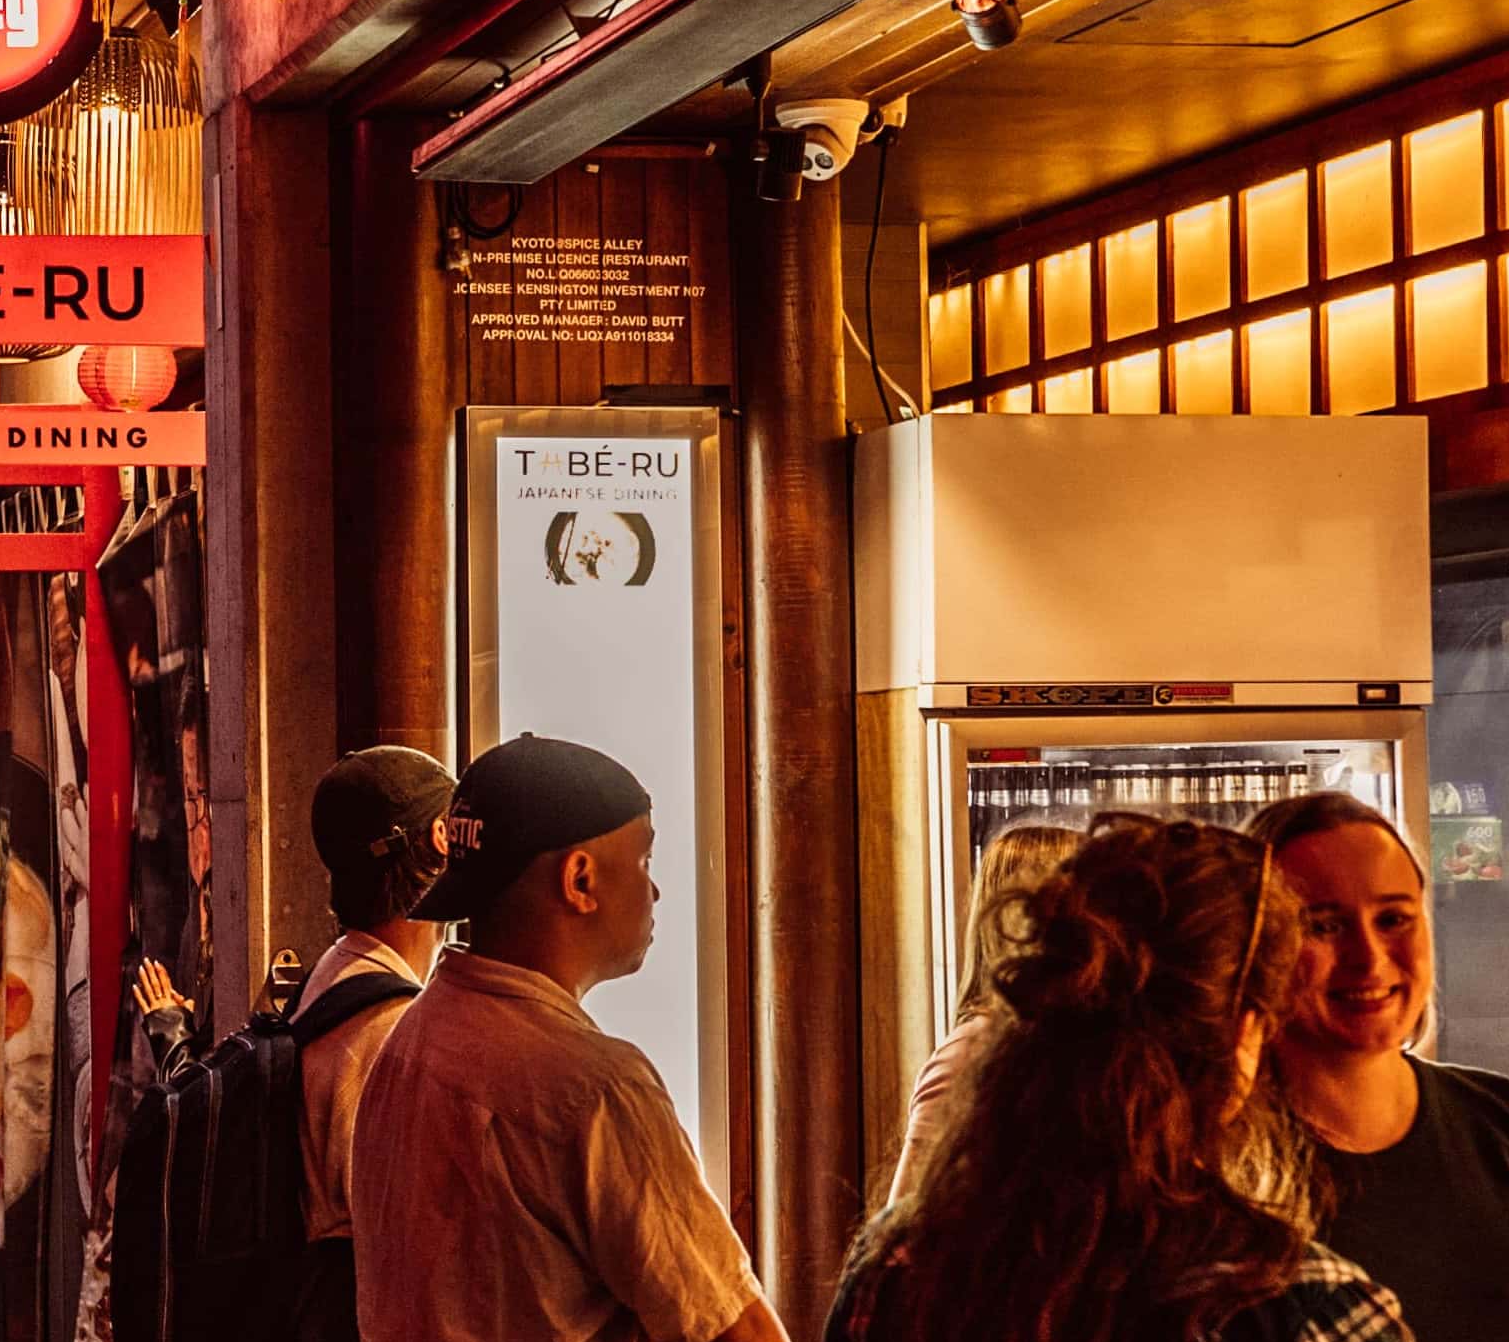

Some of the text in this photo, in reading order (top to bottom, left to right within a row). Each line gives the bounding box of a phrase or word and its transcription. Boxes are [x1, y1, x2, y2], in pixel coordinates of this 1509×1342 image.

[511, 237, 555, 249] KYOTO
[603, 238, 643, 251] ALLEY
[472, 252, 543, 264] N-PREMISE
[545, 253, 600, 265] LICENCE
[453, 282, 513, 295] ICENSEE:
[516, 283, 598, 296] KENSINGTON
[601, 285, 681, 297] INVESTMENT
[539, 299, 617, 311] PTY LIMITED
[471, 313, 686, 328] APPROVED MANAGER: DAVID BUTT
[482, 328, 548, 340] APPROVAL
[551, 329, 574, 341] NO:
[8, 426, 148, 449] DINING
[972, 686, 1151, 706] SKOPE
